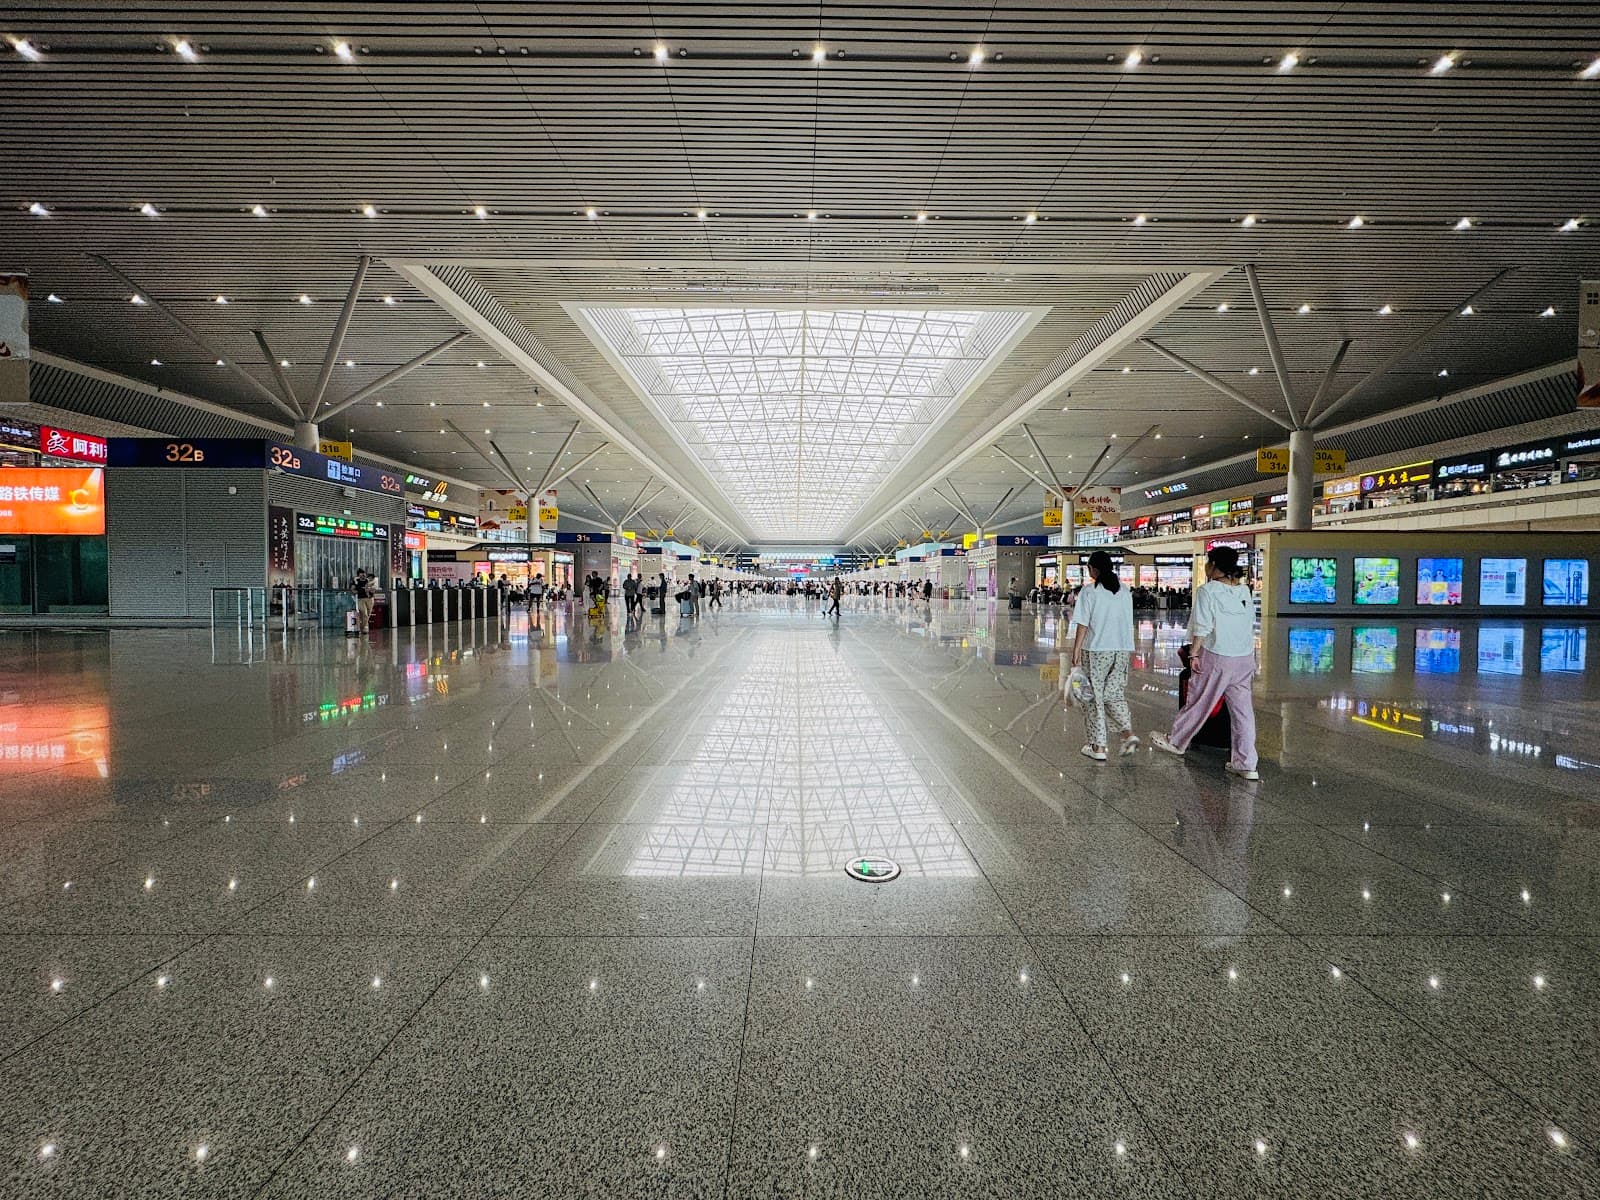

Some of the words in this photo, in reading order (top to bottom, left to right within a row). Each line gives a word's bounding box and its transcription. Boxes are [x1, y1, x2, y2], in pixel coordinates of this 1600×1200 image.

[166, 444, 205, 462] 32B
[321, 444, 340, 454] 31B
[270, 446, 301, 469] 32B
[1260, 451, 1278, 460] 30A
[1315, 452, 1333, 461] 30A
[1269, 462, 1287, 470] 31A
[1325, 462, 1343, 471] 31A
[380, 475, 401, 492] 32B
[1014, 536, 1029, 545] 31A
